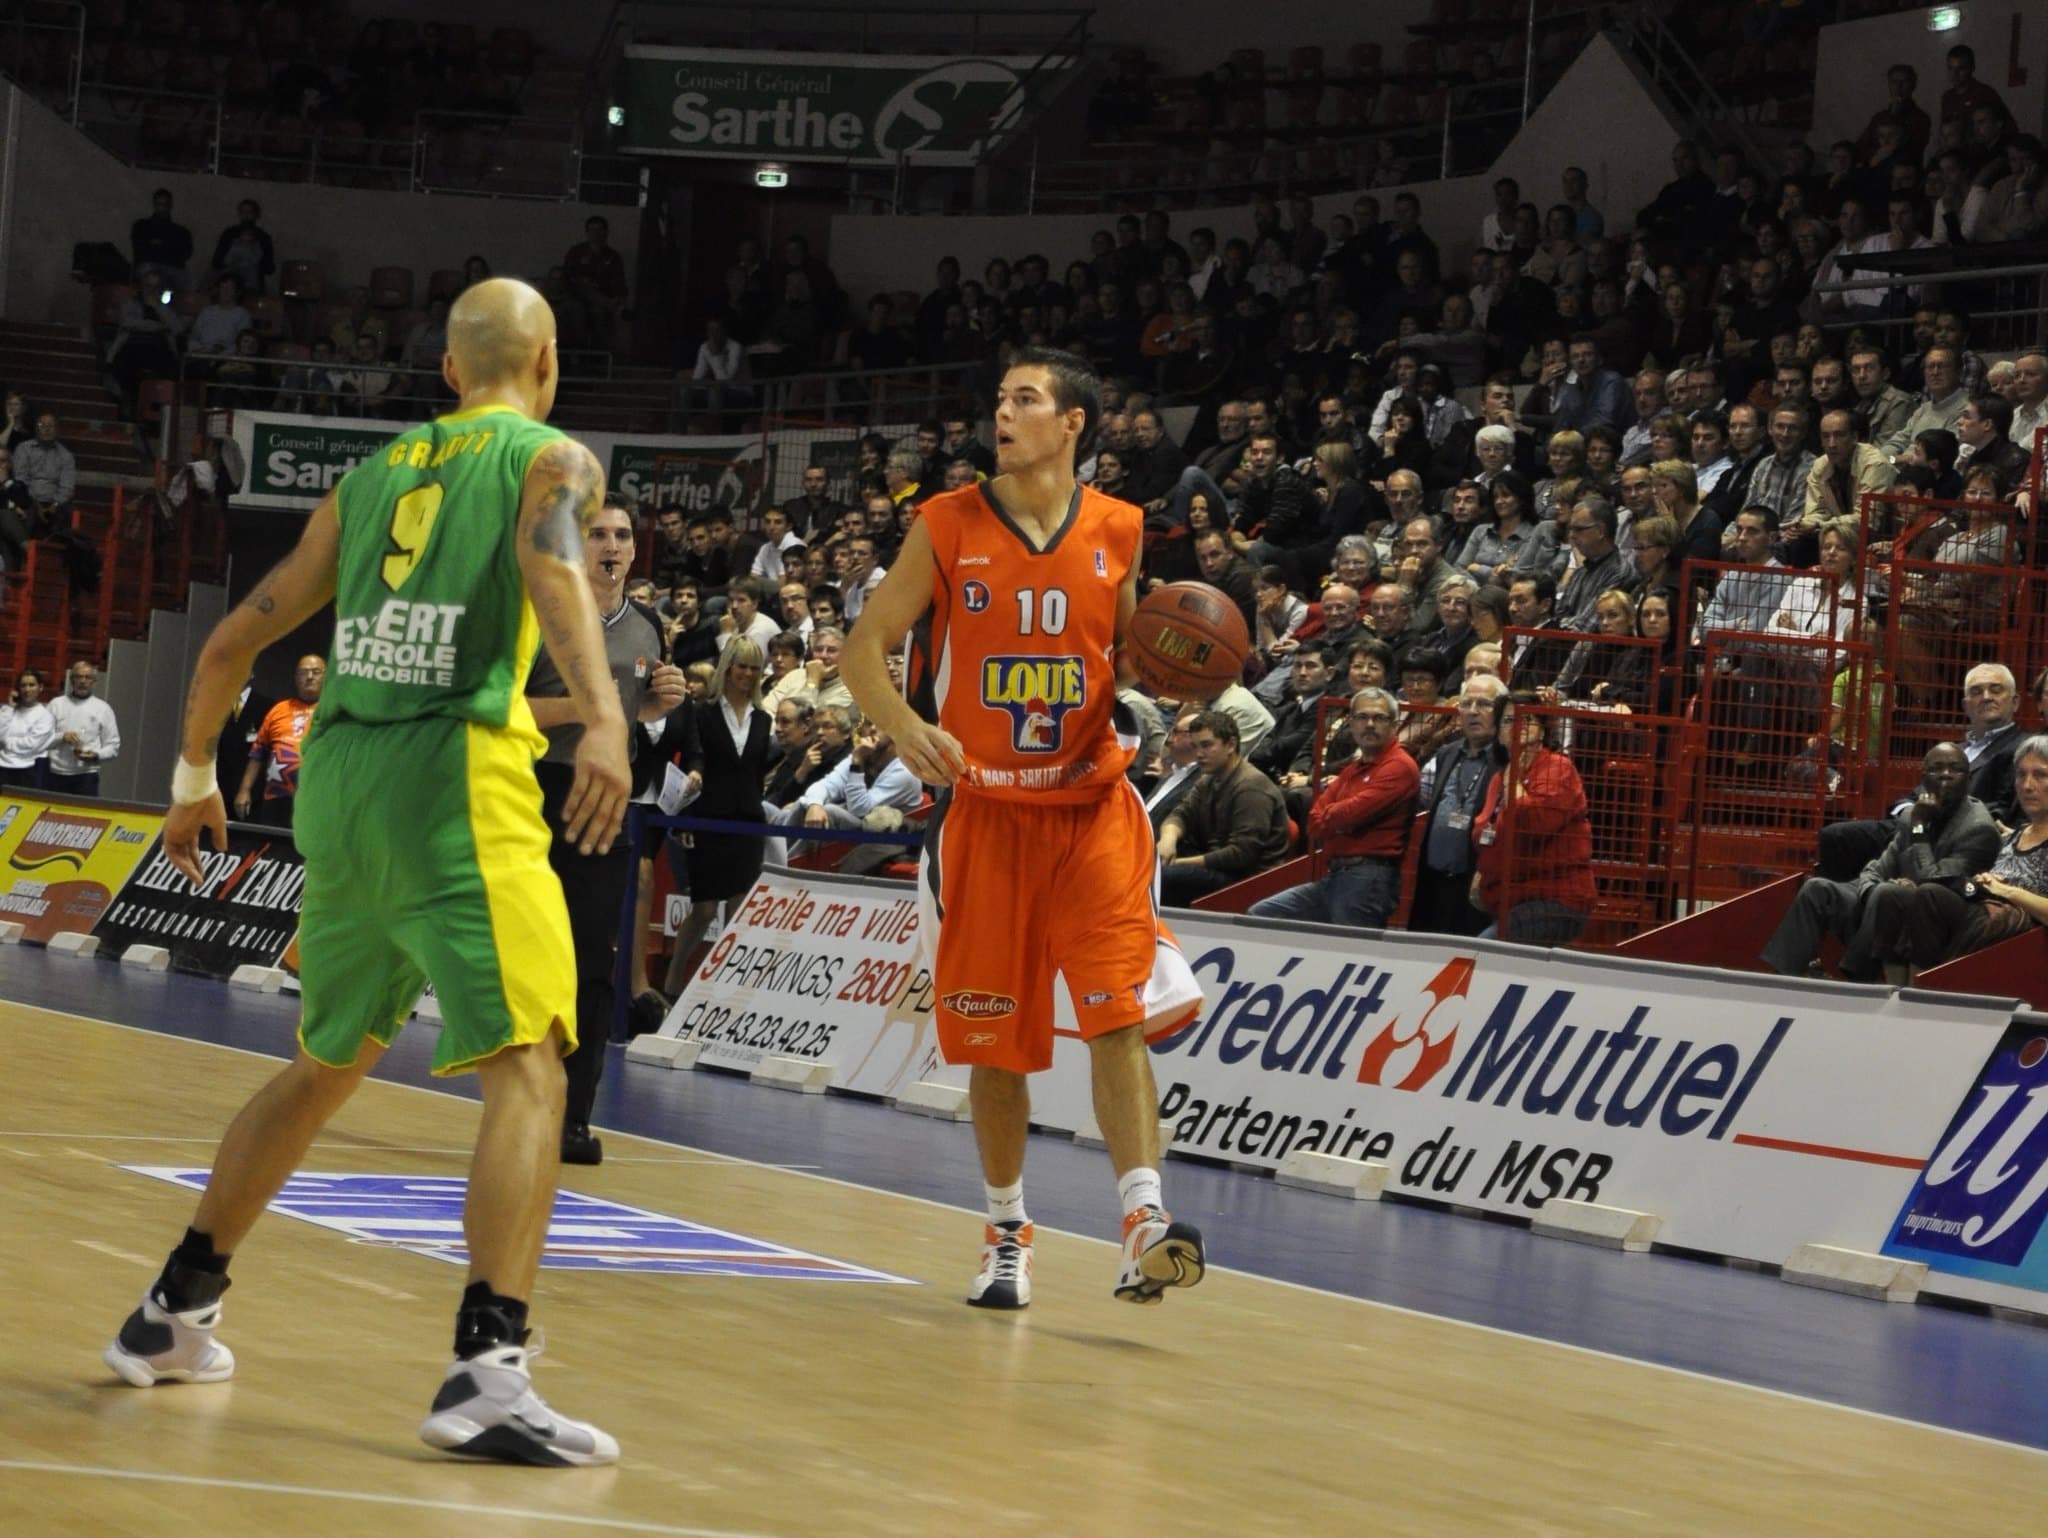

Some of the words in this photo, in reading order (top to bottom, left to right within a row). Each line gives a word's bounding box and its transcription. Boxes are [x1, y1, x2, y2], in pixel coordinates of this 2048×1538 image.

[674, 68, 749, 91] Conseil
[756, 71, 832, 94] Général
[669, 92, 864, 149] Sarthe
[269, 433, 325, 450] Conseil
[618, 471, 711, 511] Sarthe
[379, 480, 445, 593] 9
[1015, 588, 1068, 636] 10
[985, 658, 1082, 704] LOUÉ
[981, 768, 1014, 787] MANS
[108, 901, 226, 943] RESTAURANT
[228, 924, 286, 953] GRILL
[734, 884, 816, 932] Facile
[812, 901, 861, 938] ma
[861, 898, 920, 945] ville
[700, 932, 737, 981] 9
[836, 957, 912, 1006] 2600
[956, 993, 1014, 1015] Gaulois
[1150, 946, 1393, 1080] Crédit
[697, 1005, 839, 1059] 02.43.23.42.25
[1441, 983, 1796, 1142] Mutuel
[1159, 1081, 1396, 1162] Partenaire
[1400, 1126, 1478, 1193] du
[1478, 1140, 1614, 1210] MSB
